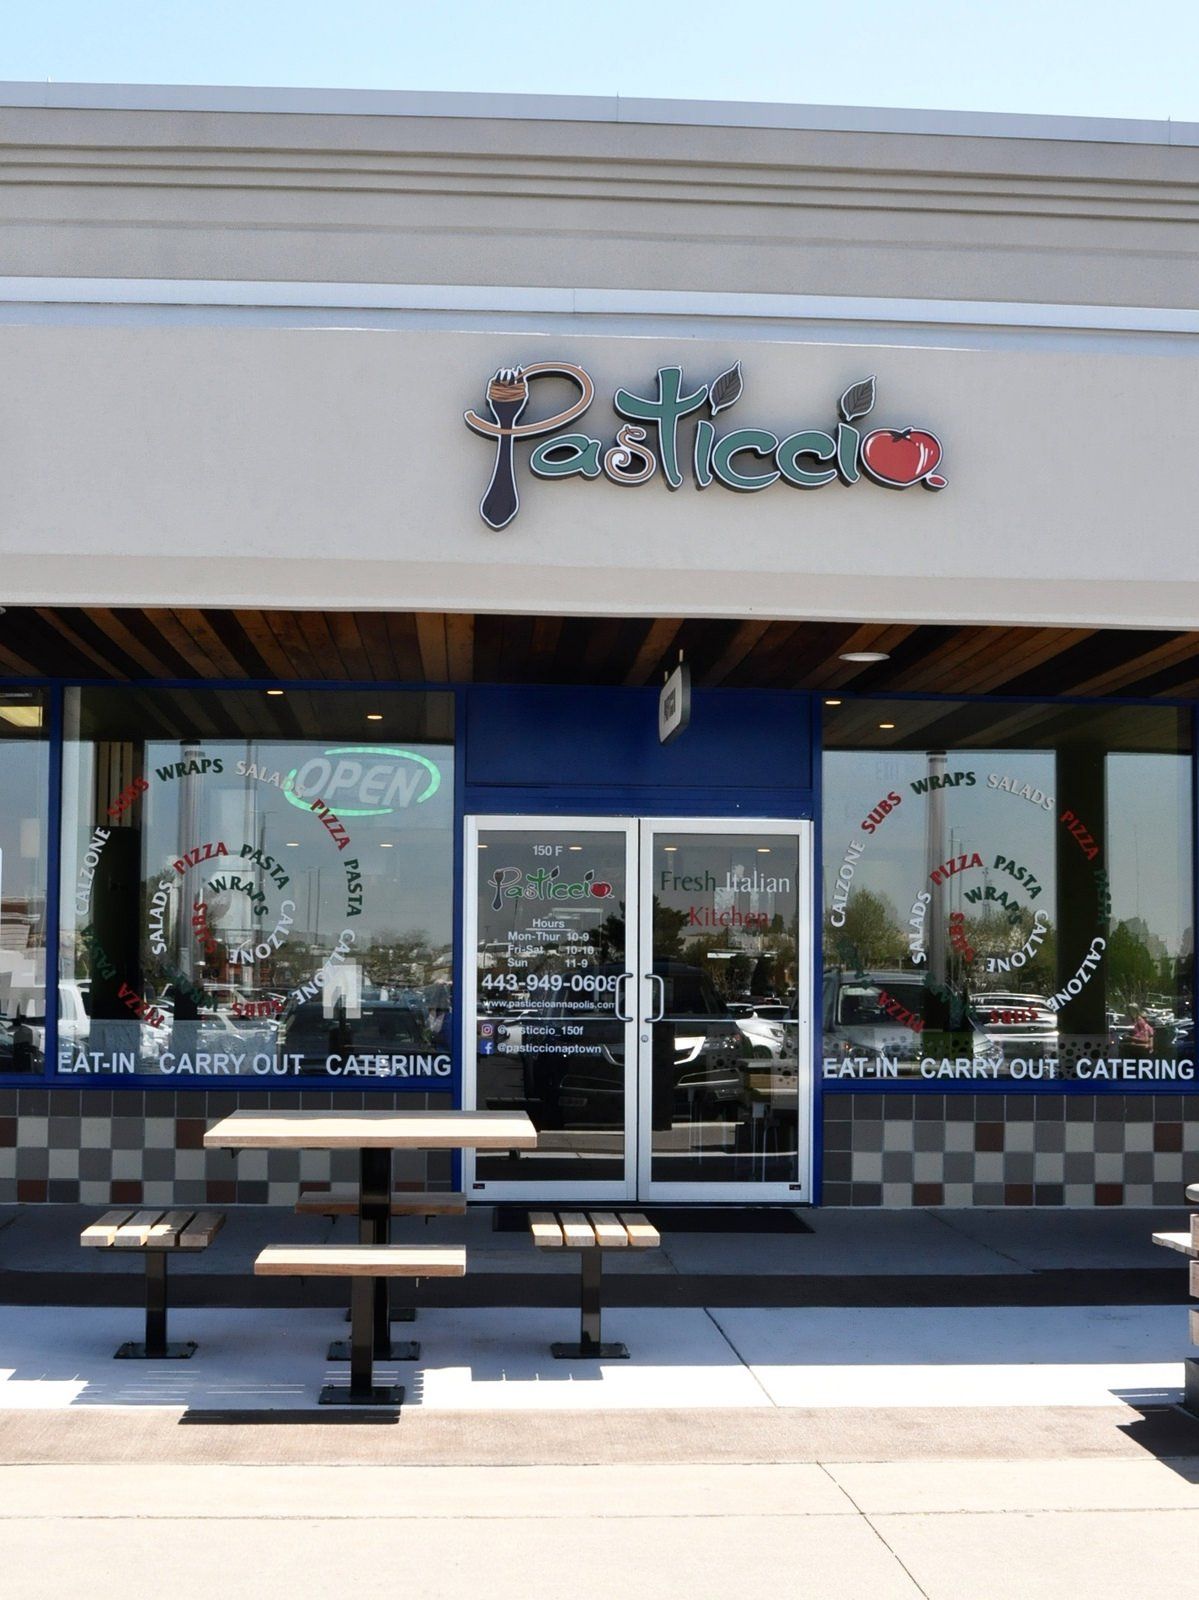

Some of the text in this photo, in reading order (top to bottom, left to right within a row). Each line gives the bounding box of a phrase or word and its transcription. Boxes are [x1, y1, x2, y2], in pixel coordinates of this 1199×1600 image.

[464, 360, 949, 530] Pasticcio
[155, 757, 224, 783] WRAPS
[235, 760, 306, 799] SALADS
[298, 757, 425, 808] OPEN
[910, 771, 976, 796] WRAPS
[107, 777, 150, 820] SUBS
[986, 773, 1056, 812] SALADS
[310, 798, 351, 852] PIZZA
[861, 791, 902, 835] SUBS
[532, 844, 563, 857] 150 F
[1059, 809, 1099, 861] PIZZA
[75, 826, 111, 916] CALZONE
[172, 841, 229, 876] PIZZA
[240, 843, 290, 890] PASTA
[929, 852, 984, 886] PIZZA
[993, 854, 1042, 900] PASTA
[208, 875, 269, 917] WRAPS
[344, 858, 363, 917] PASTA
[487, 865, 615, 911] Pasticcio
[660, 870, 790, 893] Fresh Italian
[830, 839, 865, 928] CALZONE
[151, 880, 173, 956] SALADS
[532, 918, 565, 929] Hours
[689, 906, 770, 926] Kitchen
[964, 886, 1023, 925] WRAPS
[192, 902, 218, 954] SUBS
[228, 899, 297, 965] CALZONE
[507, 931, 590, 942] Mon-Thur 10-9
[911, 889, 932, 965] SALADS
[949, 911, 975, 964] SUBS
[986, 908, 1049, 973] CALZONE
[291, 928, 356, 1005] CALZONE
[507, 944, 595, 955] Fri-Sat 10-10
[507, 957, 588, 968] Sun 11-9
[481, 973, 616, 992] 443-949-0608
[1045, 936, 1106, 1014] CALZONE
[117, 982, 165, 1028] PIZZA
[231, 999, 284, 1018] SUBS
[877, 990, 926, 1034] PIZZA
[990, 1007, 1039, 1025] SUBS
[57, 1051, 135, 1074] EAT-IN
[159, 1052, 304, 1076] CARRY OUT
[325, 1054, 452, 1077] CATERING
[822, 1056, 898, 1078] EAT-IN
[919, 1057, 1060, 1080] CARRY OUT
[1076, 1058, 1195, 1080] CATERING
